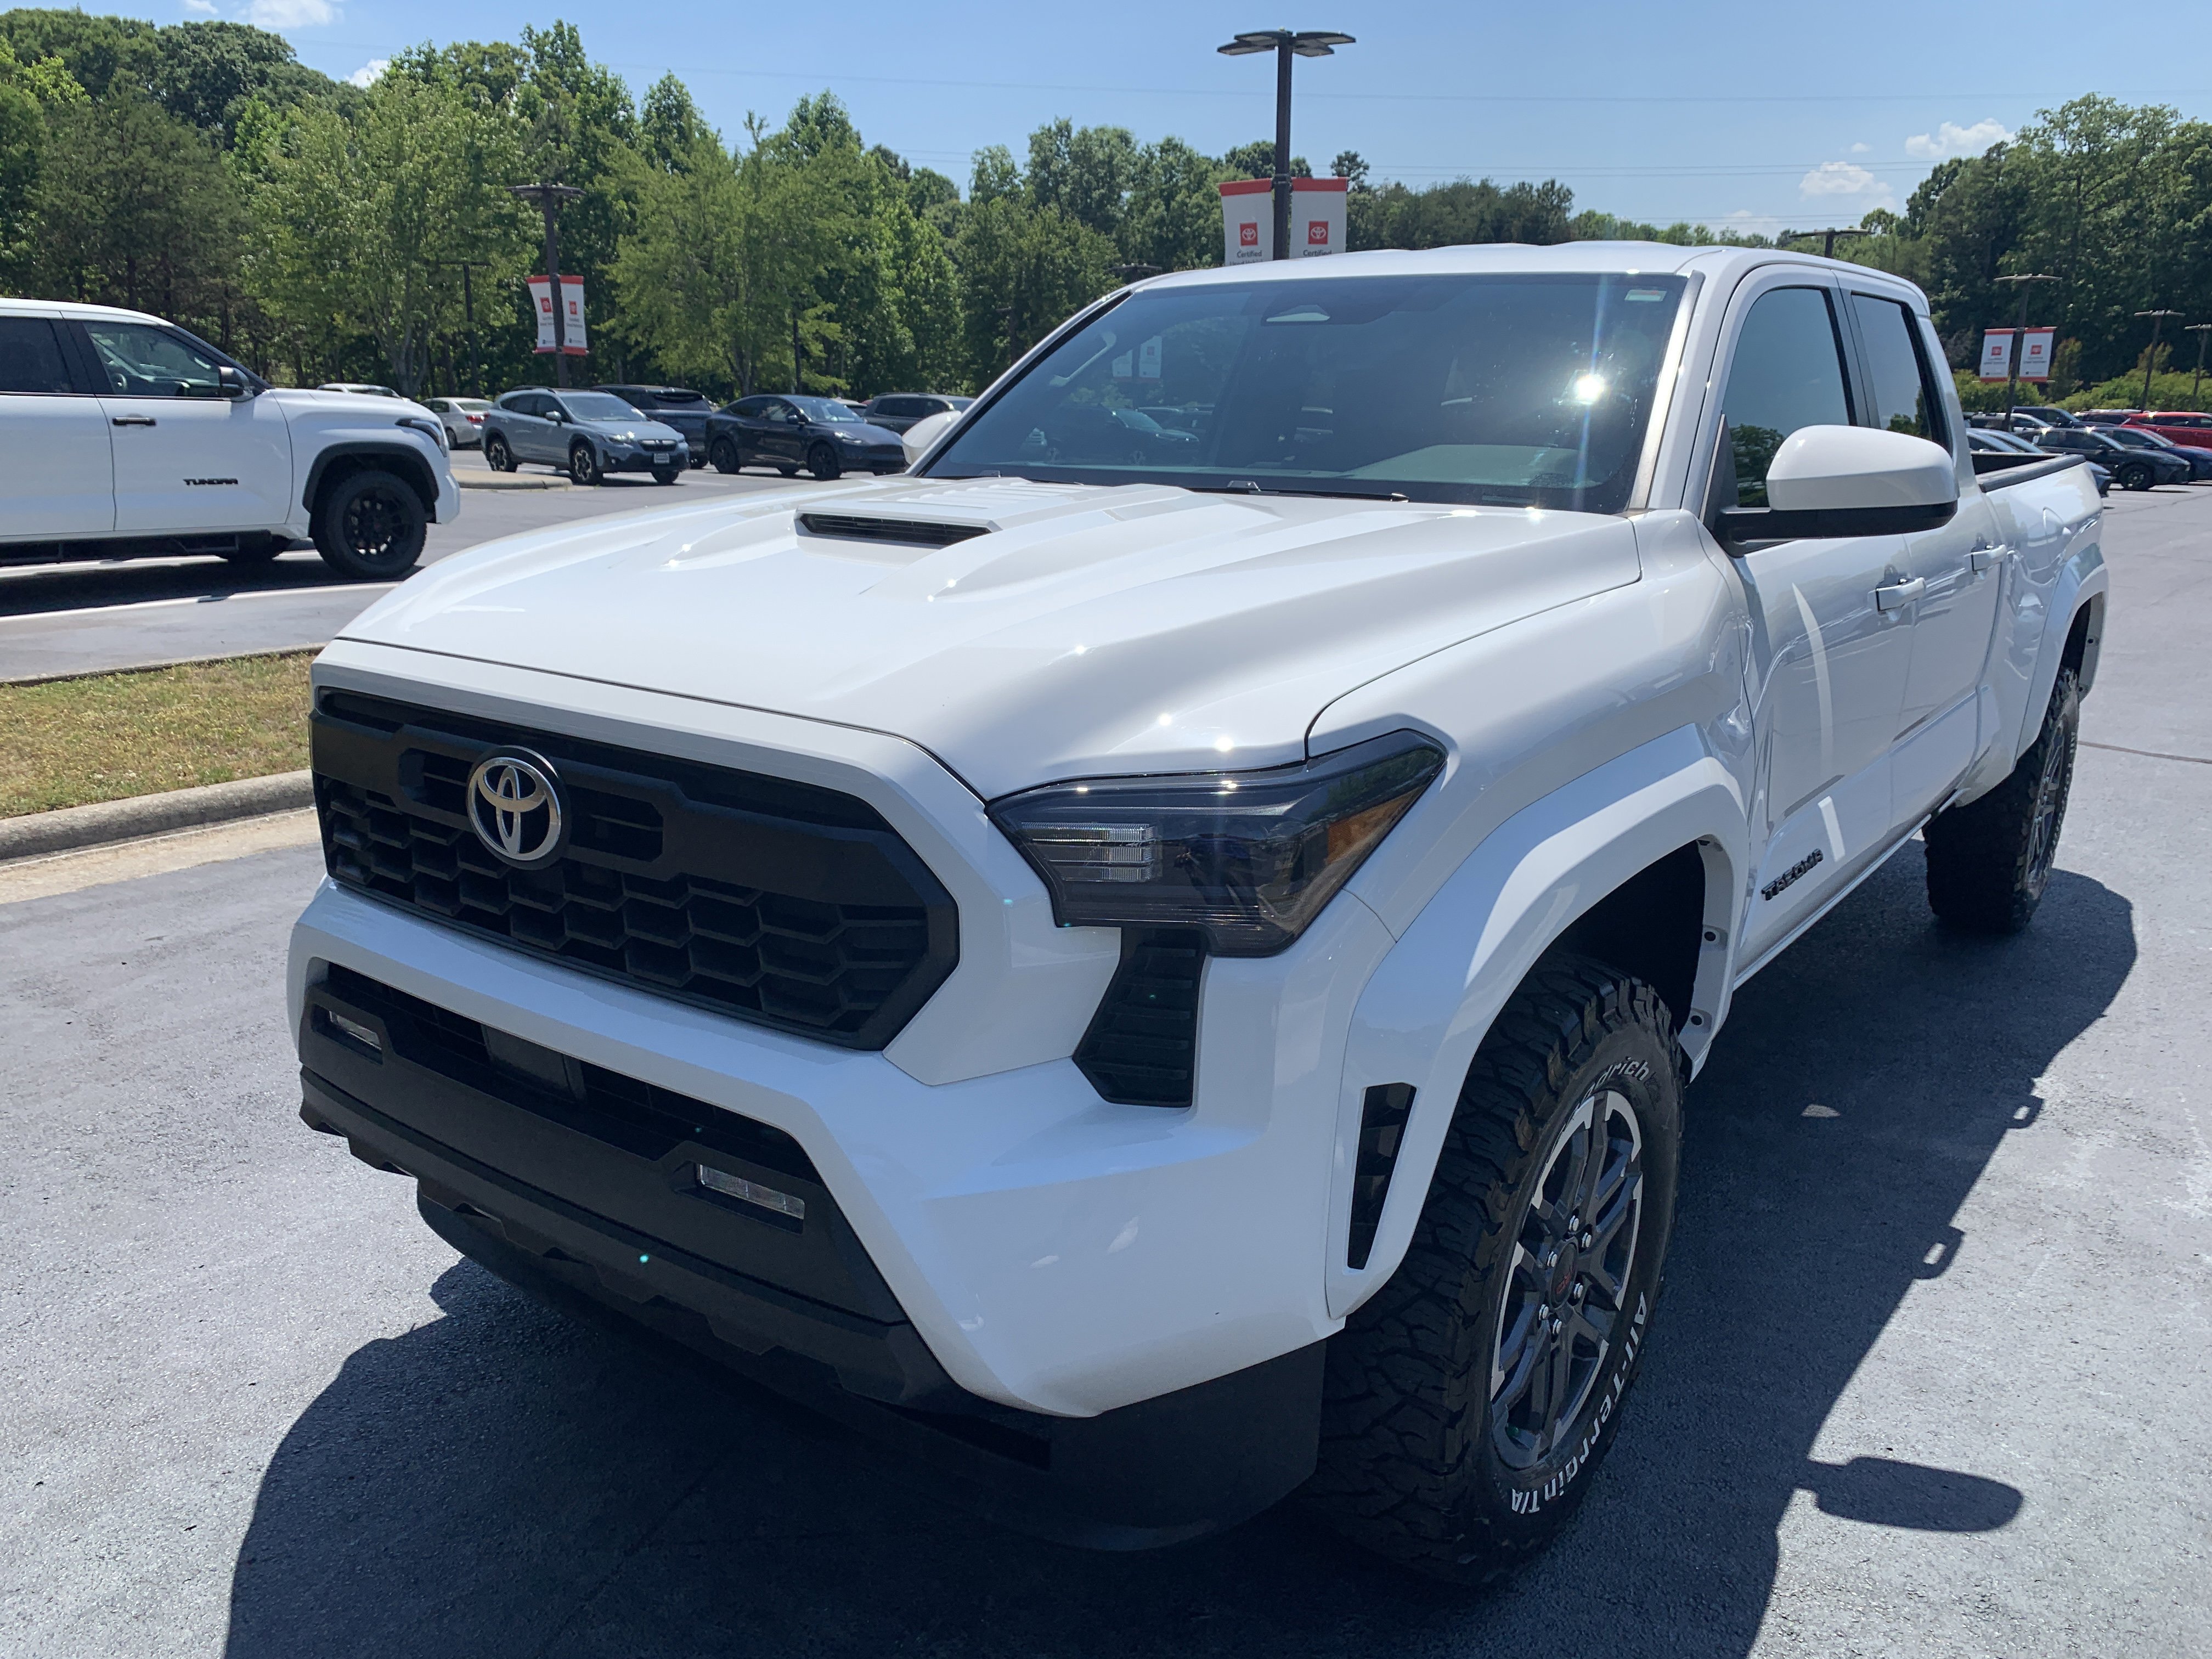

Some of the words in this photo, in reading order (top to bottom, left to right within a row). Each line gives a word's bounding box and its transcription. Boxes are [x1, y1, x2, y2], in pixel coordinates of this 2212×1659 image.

[1237, 250, 1262, 258] Certified
[1761, 848, 1824, 901] TACOMA
[1511, 1488, 1540, 1514] T/A
